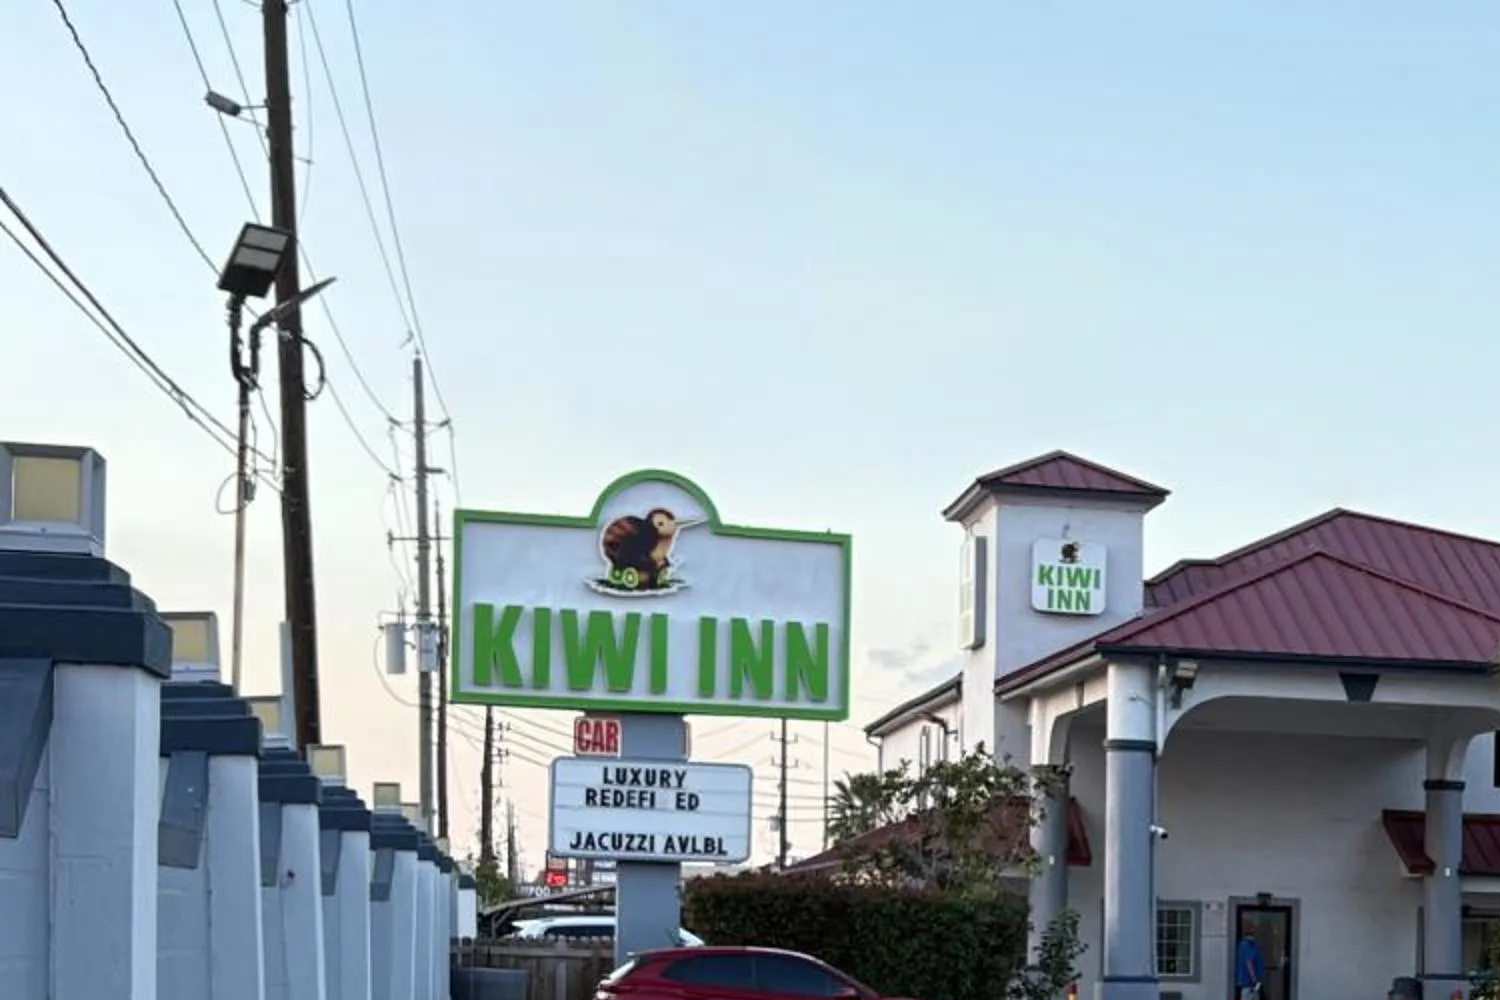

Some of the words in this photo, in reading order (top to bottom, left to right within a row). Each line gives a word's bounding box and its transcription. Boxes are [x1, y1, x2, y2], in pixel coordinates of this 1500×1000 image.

[1038, 564, 1101, 589] KIWI
[1047, 588, 1091, 611] INN
[473, 603, 669, 695] KIWI
[698, 616, 829, 704] INN
[576, 719, 619, 753] CAR
[603, 766, 687, 789] LUXURY
[569, 831, 655, 852] JACUZZI
[663, 837, 728, 857] AVLBL
